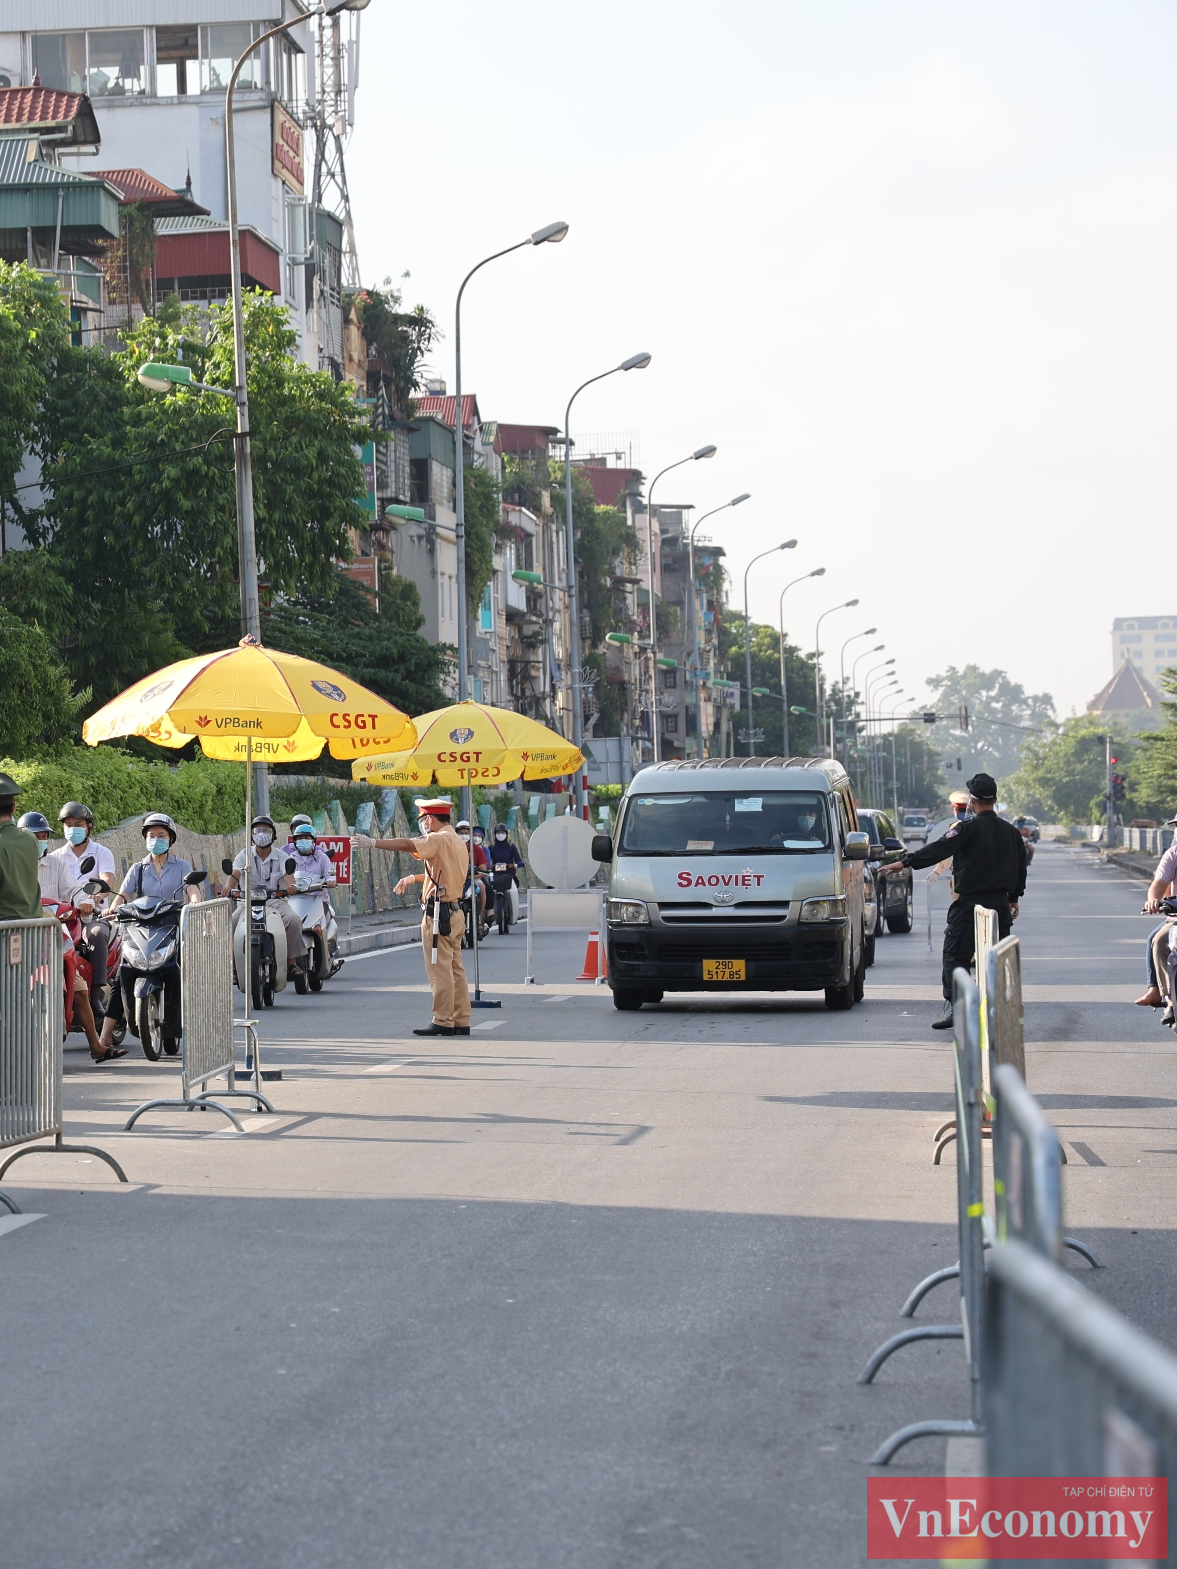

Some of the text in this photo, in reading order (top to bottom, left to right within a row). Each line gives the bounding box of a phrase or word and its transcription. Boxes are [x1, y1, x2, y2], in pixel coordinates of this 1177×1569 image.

[214, 717, 263, 729] VPBank
[329, 713, 379, 730] CSGT
[437, 752, 482, 763] CSGT
[531, 753, 557, 761] VPBank
[339, 857, 348, 878] TẾ
[714, 960, 734, 970] 29D
[707, 970, 742, 980] 517.85
